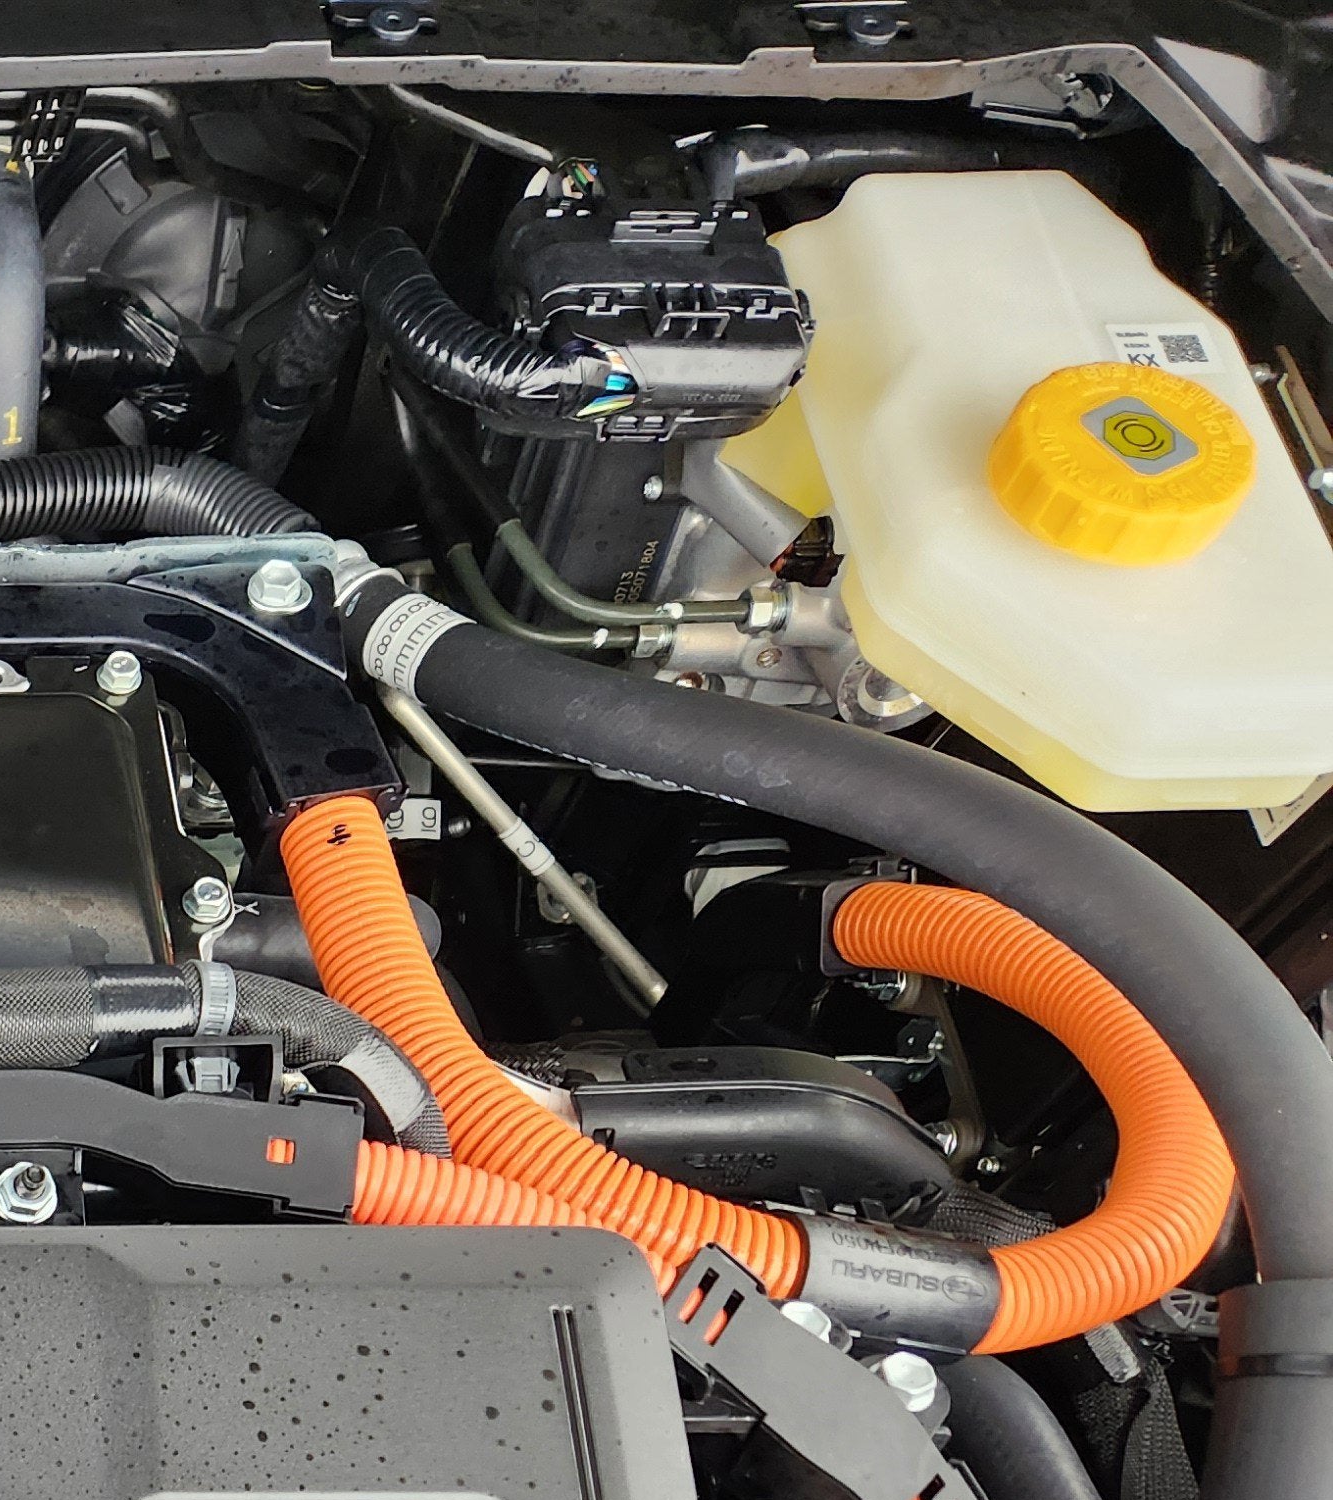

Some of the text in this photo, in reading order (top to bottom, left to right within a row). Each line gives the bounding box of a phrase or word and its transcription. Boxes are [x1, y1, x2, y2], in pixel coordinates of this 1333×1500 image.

[1127, 353, 1161, 368] KX
[2, 407, 23, 445] 1
[832, 1259, 940, 1293] SUBARU
